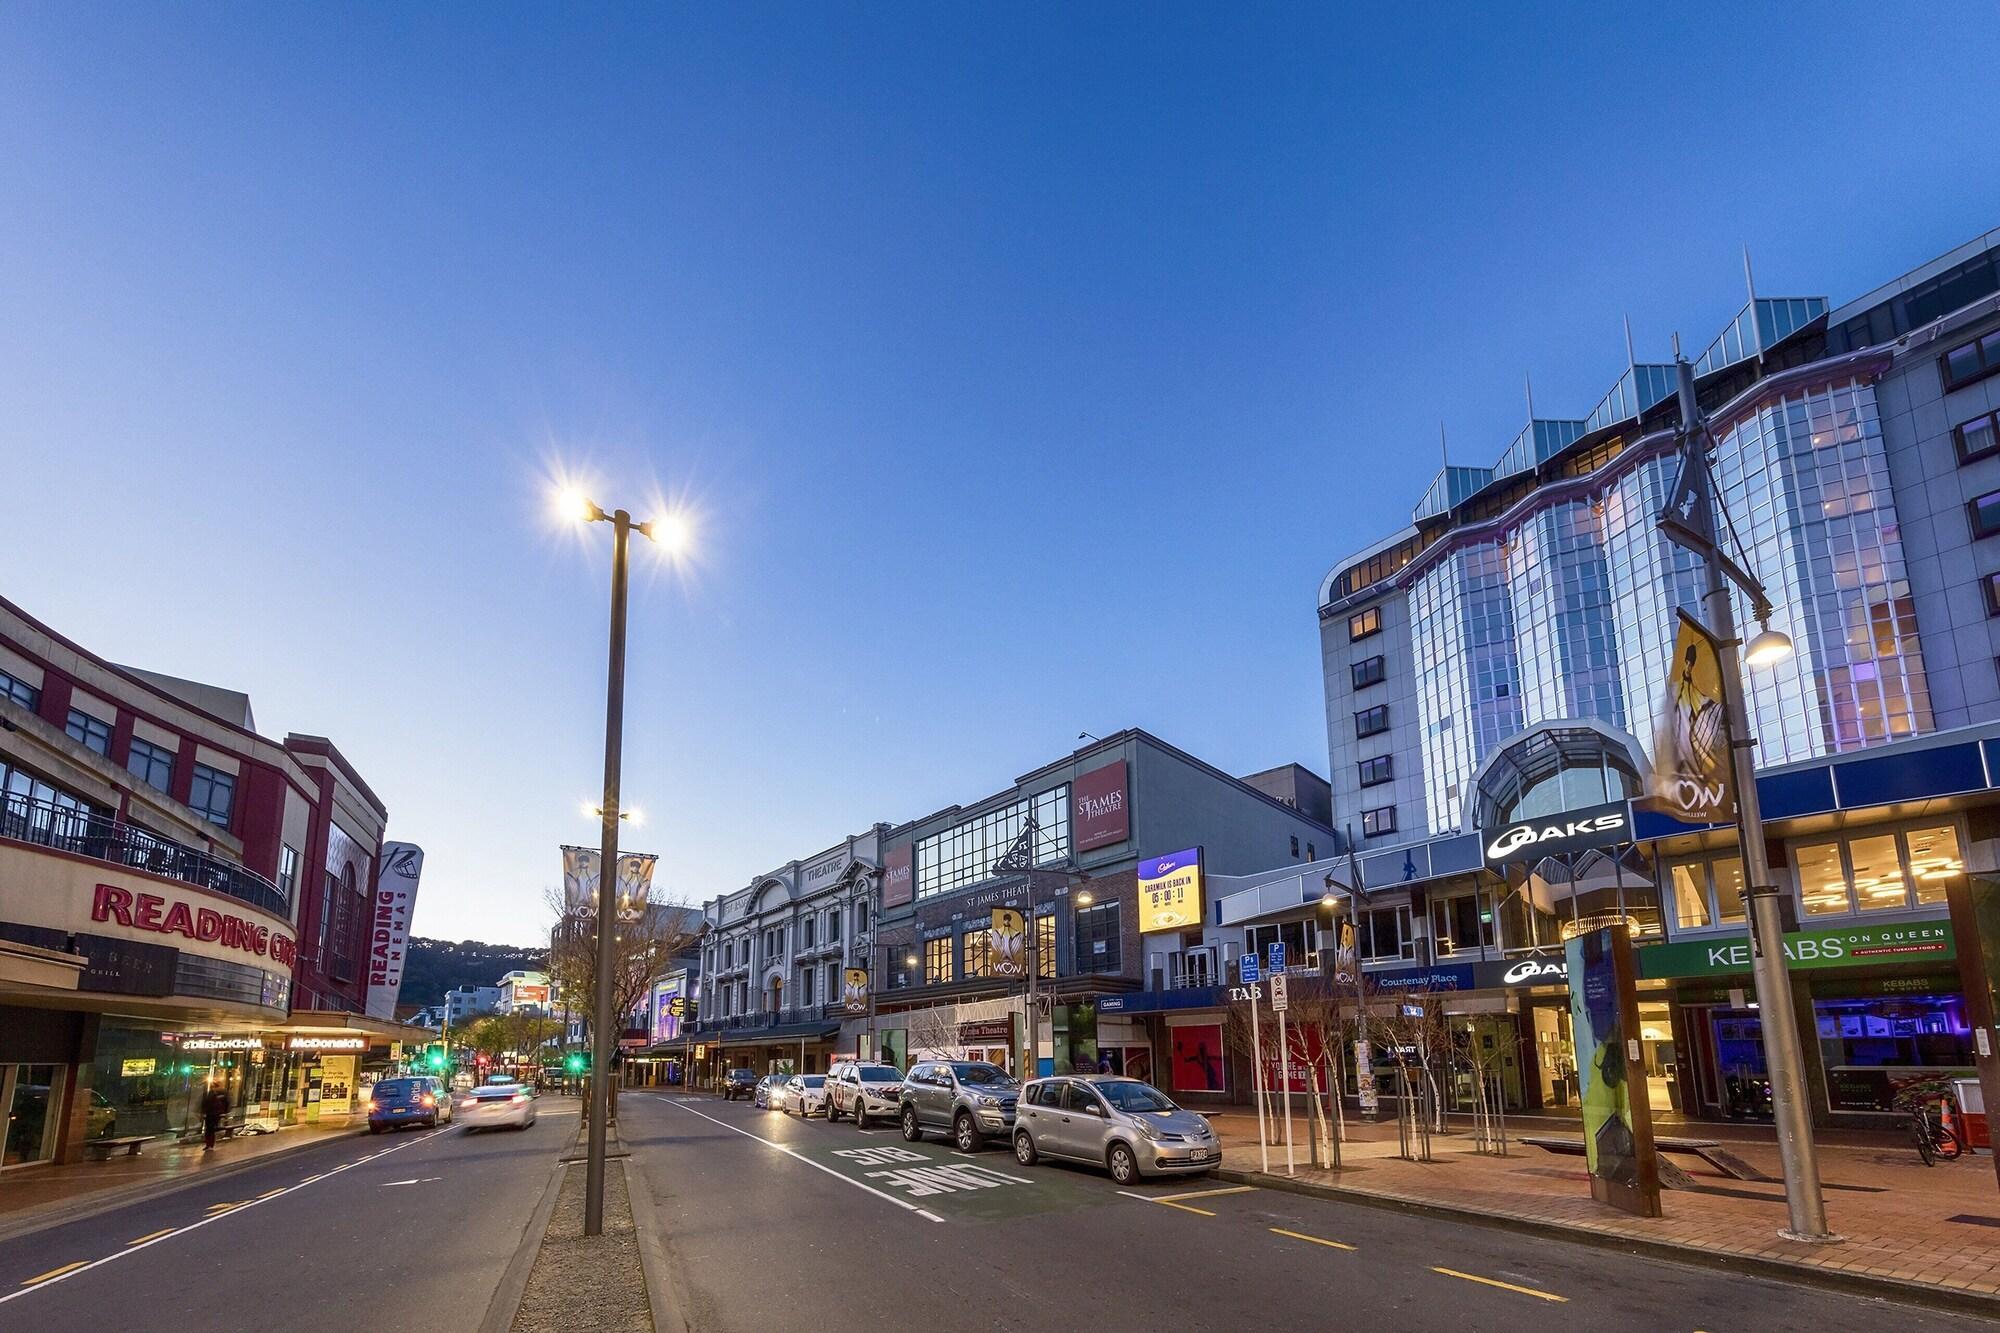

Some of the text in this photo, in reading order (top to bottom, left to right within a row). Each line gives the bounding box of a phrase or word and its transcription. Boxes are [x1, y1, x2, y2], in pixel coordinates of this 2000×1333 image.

[1091, 802, 1122, 818] THEATRE
[1487, 813, 1624, 859] OAKS
[808, 859, 842, 881] THEATRE
[1145, 876, 1191, 893] CARAMILK IS BACK IN
[966, 897, 975, 907] ST
[977, 891, 999, 906] JAMES
[92, 884, 268, 955] READING
[370, 892, 395, 986] READING
[389, 892, 407, 987] CINEMAS
[1849, 935, 1870, 943] ON
[1881, 929, 1944, 940] QUEEN
[1381, 974, 1458, 986] Courtenay Place
[981, 1025, 1008, 1035] Theatre
[290, 1037, 364, 1049] McDonald's
[832, 1146, 933, 1166] BUS
[864, 1163, 1035, 1197] LANE
